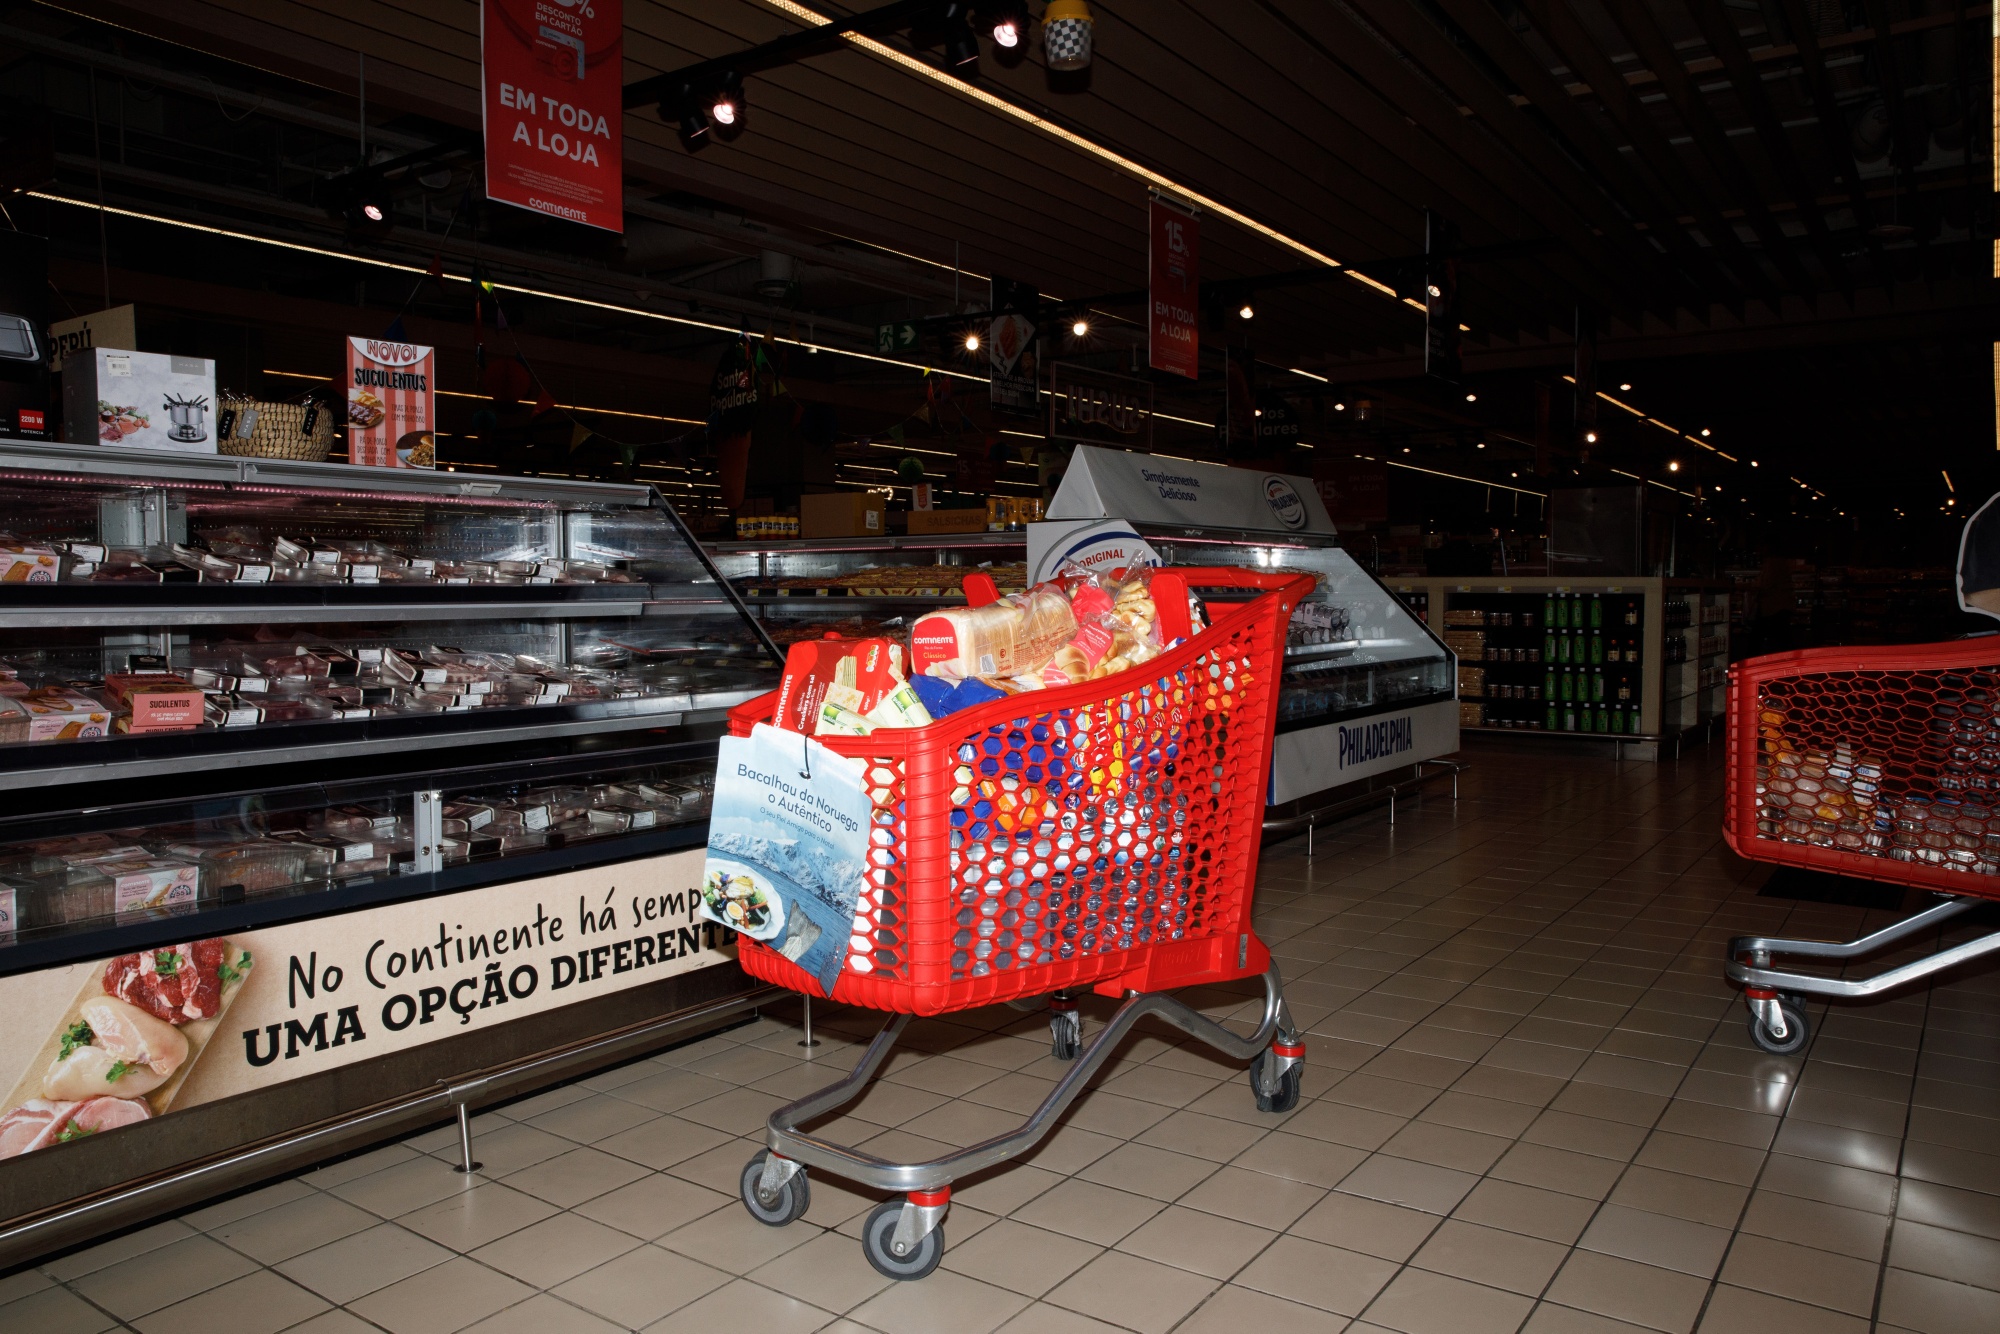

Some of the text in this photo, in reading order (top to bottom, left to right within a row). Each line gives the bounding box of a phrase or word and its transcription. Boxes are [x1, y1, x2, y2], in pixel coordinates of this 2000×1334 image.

[535, 12, 583, 37] EM CARTÃO
[536, 2, 581, 26] DESCONTO
[500, 83, 611, 140] EM TODA
[513, 121, 600, 168] A LOJA
[529, 197, 588, 222] CONTINENTE
[1155, 301, 1195, 326] EM TODA
[1160, 321, 1192, 343] A LOJA
[367, 340, 417, 363] NOVO!
[355, 368, 427, 393] SUCULENTUS
[710, 388, 758, 416] Populares
[21, 415, 44, 425] 2200 W
[1141, 469, 1201, 488] Simplesmente
[1362, 473, 1384, 482] TODA
[1158, 487, 1197, 501] Delicioso
[926, 515, 980, 527] SALSICHAS
[913, 636, 954, 645] CONTINENTE
[149, 699, 190, 709] SUCULENTUS
[773, 674, 794, 729] CONTINENTE
[797, 699, 809, 730] Crackers
[1338, 716, 1413, 770] PHILADELPHIA
[737, 763, 858, 833] Bacalhau da Noruega
[766, 810, 776, 819] seu
[768, 794, 832, 832] o Autêntico
[288, 886, 702, 1009] No Continente há semp
[243, 920, 738, 1067] UMA OPÇÃO DIFERENTE
